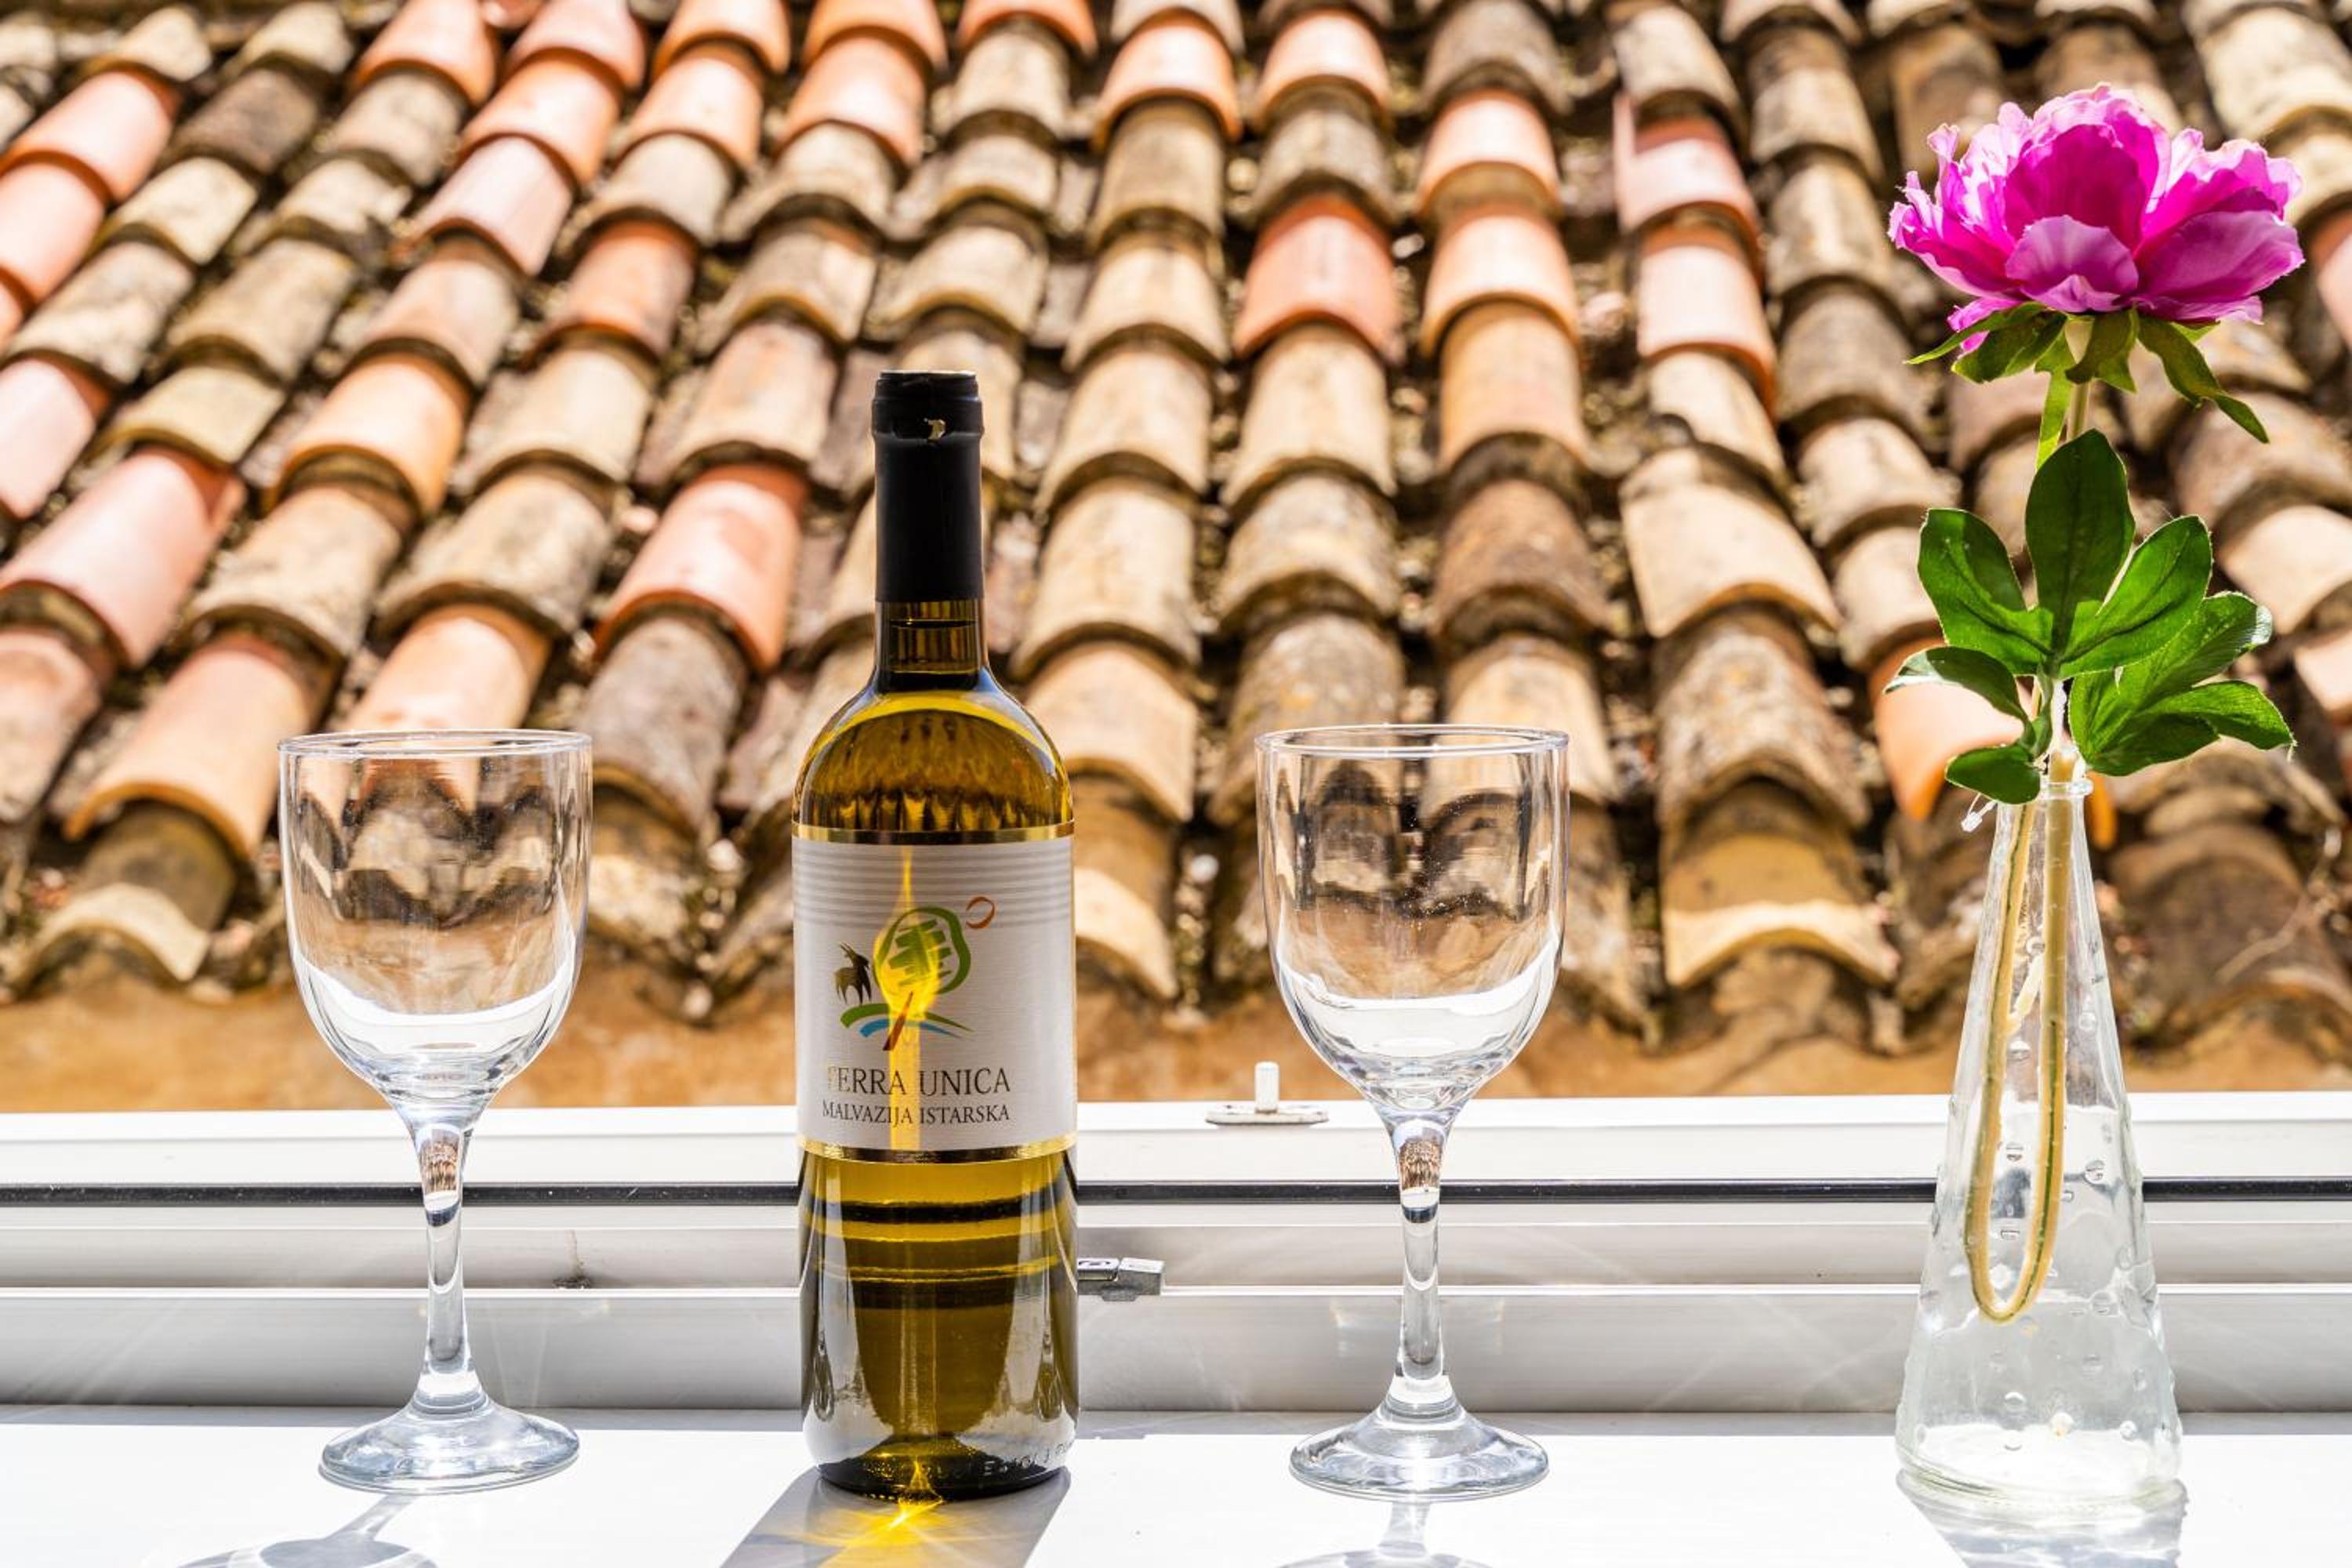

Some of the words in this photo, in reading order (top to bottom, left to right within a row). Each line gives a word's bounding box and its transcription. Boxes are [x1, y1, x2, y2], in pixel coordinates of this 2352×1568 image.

[920, 1067, 1011, 1097] UNICA
[822, 1099, 913, 1128] MALVAZIJA
[920, 1105, 1010, 1124] ISTARSKA
